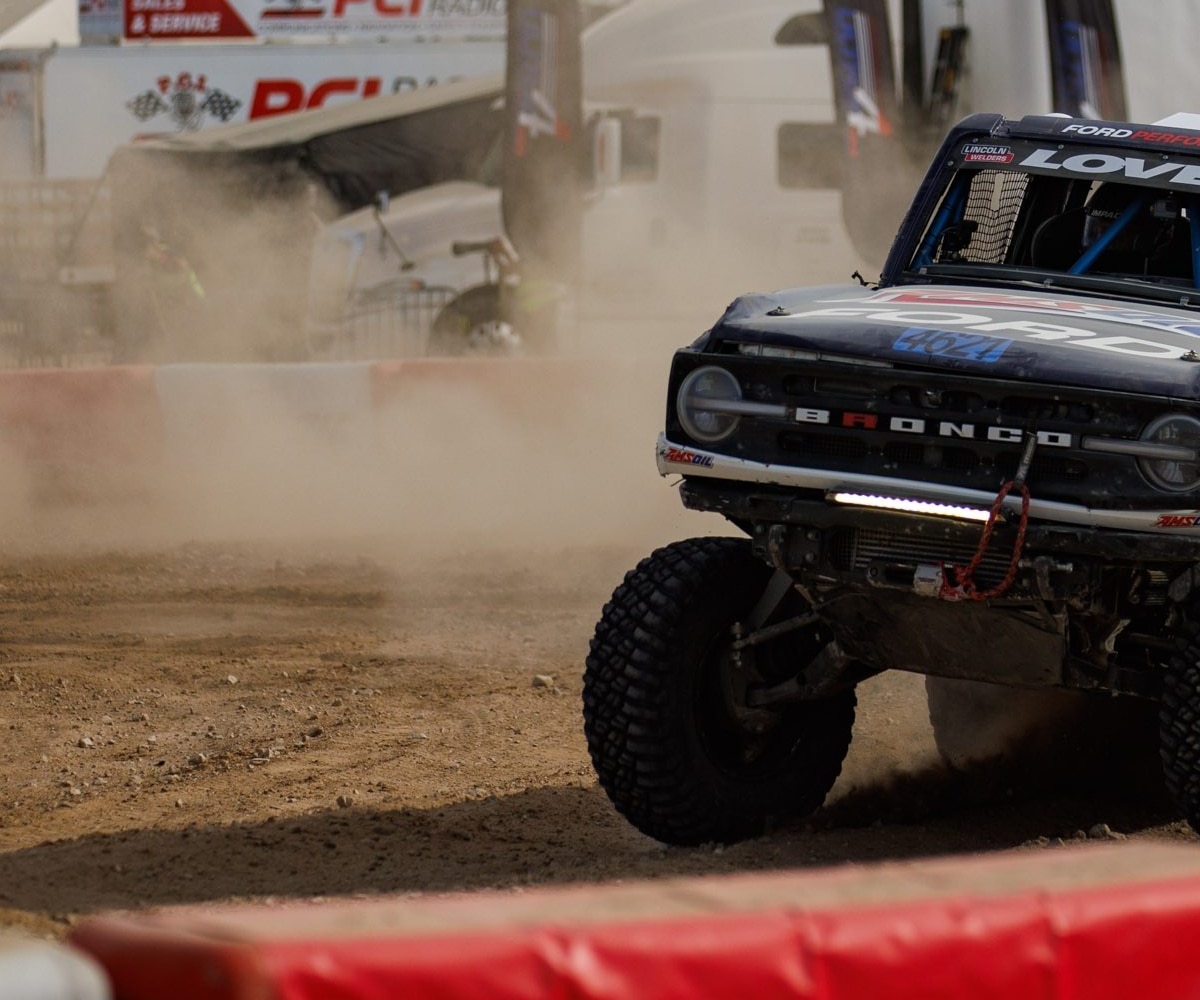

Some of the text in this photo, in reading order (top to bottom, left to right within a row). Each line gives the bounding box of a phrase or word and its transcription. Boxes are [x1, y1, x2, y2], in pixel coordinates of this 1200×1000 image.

[150, 13, 221, 33] SERVICE
[1062, 123, 1133, 140] FORD
[963, 144, 1008, 156] LINCOLN
[970, 153, 1009, 163] WELDERS
[1091, 208, 1122, 219] IMPAC
[783, 306, 1193, 361] FORD
[795, 407, 1073, 448] BRONCO
[664, 448, 715, 469] AMSOIL
